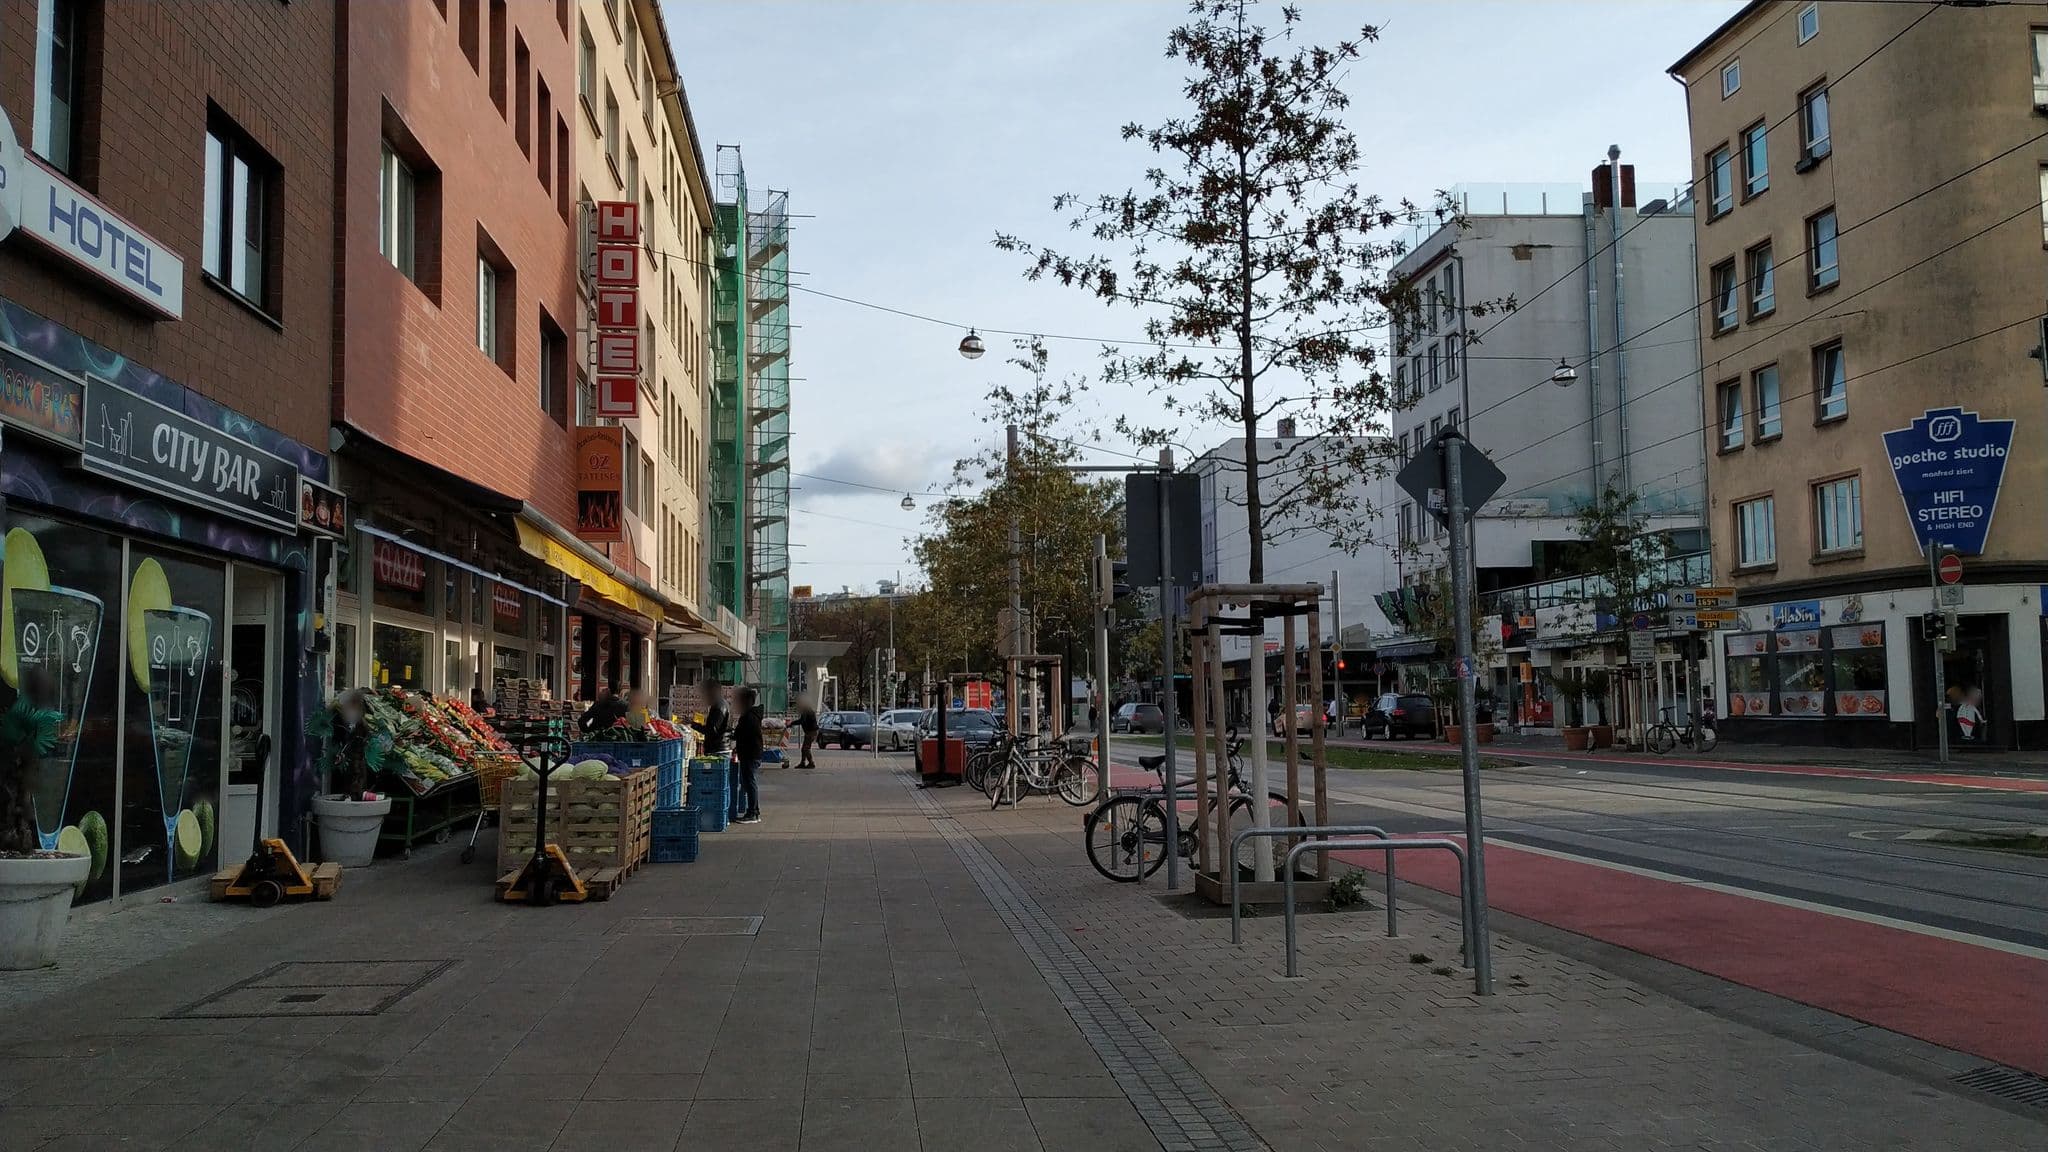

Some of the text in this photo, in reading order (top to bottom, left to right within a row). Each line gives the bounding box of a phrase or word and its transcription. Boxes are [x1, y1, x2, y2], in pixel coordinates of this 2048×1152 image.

[49, 185, 163, 297] HOTEL
[601, 205, 635, 413] HOTEL
[152, 422, 260, 501] CITY BAR
[1893, 444, 2006, 470] goethe studio
[1922, 468, 1954, 479] manfred
[1933, 490, 1965, 505] HIFI
[1918, 505, 1983, 522] STEREO
[1926, 523, 1933, 531] &
[1957, 521, 1975, 529] END
[1775, 604, 1815, 627] Aladin
